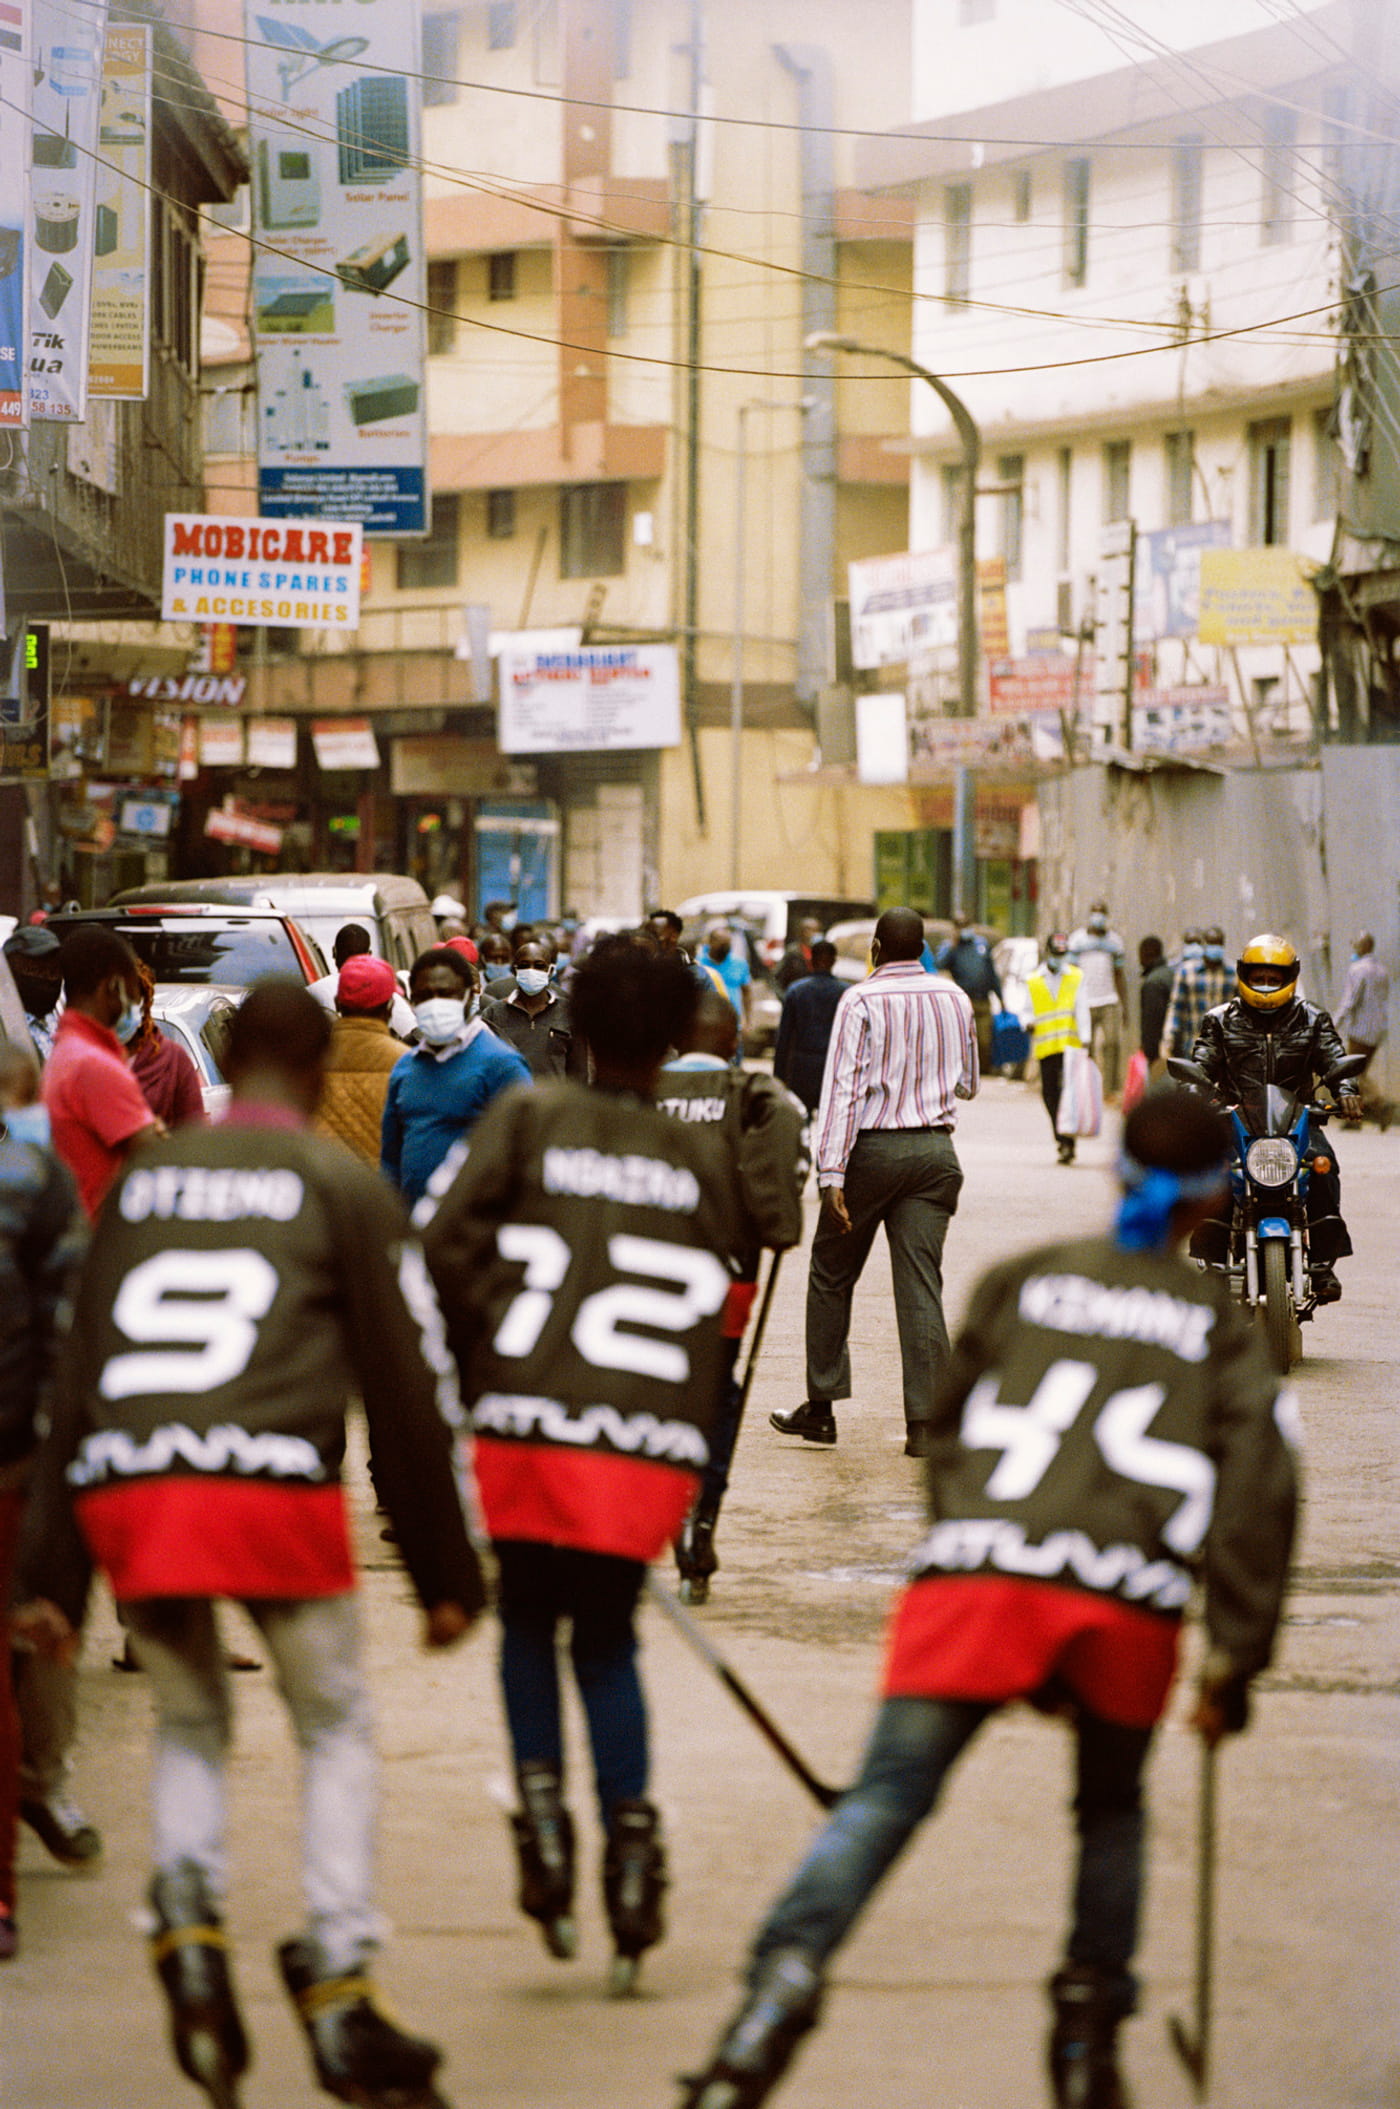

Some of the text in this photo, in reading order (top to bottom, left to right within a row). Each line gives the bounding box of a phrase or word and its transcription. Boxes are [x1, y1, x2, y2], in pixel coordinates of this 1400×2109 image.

[32, 332, 65, 349] Tik
[50, 403, 71, 415] 135
[172, 522, 353, 565] MOBICARE
[174, 567, 348, 592] PHONE SPARES
[172, 596, 348, 621] & ACCESORIES
[128, 676, 247, 706] VISION
[656, 1096, 726, 1122] TUKU
[494, 1222, 733, 1385] 12
[100, 1248, 280, 1402] 9
[959, 1357, 1219, 1557] 45
